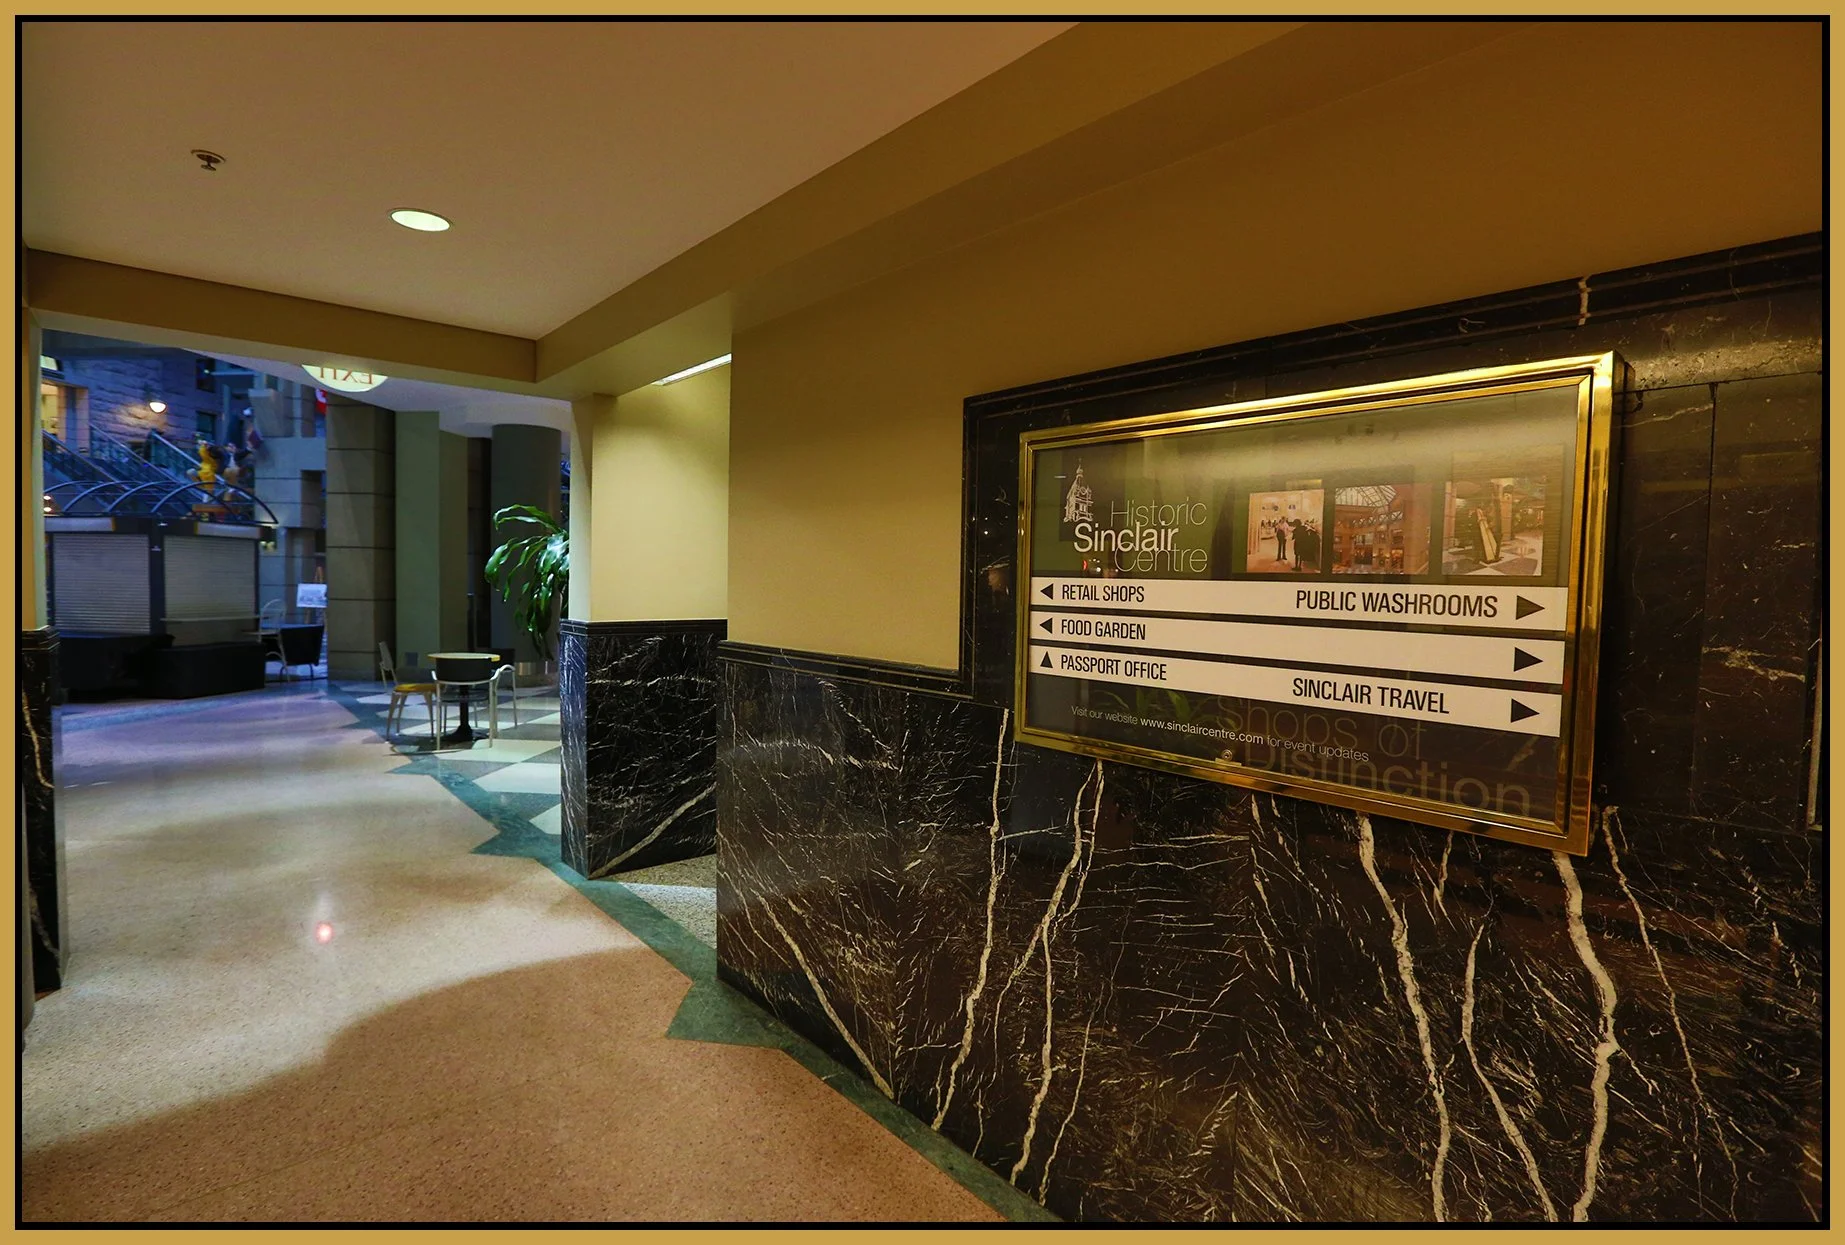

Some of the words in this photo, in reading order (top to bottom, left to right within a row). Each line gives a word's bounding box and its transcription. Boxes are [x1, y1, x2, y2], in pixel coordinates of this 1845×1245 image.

[1110, 496, 1208, 527] Historic
[1073, 521, 1179, 553] Sinclair
[1114, 541, 1208, 573] Centre
[1061, 584, 1100, 601] RETAIL
[1102, 585, 1145, 603] SHOPS
[1296, 590, 1356, 612] PUBLIC
[1362, 592, 1498, 618] WASHROOMS
[1061, 619, 1092, 636] FOOD
[1095, 621, 1146, 641] GARDEN
[1060, 654, 1121, 676] PASSPORT
[1124, 660, 1167, 681] OFFICE
[1292, 677, 1371, 705] SINCLAIR
[1377, 686, 1450, 714] TRAVEL
[1071, 706, 1088, 718] Visit
[1089, 709, 1103, 719] our
[1105, 711, 1138, 725] website
[1140, 717, 1264, 745] www.sinclaircentre.com
[1267, 735, 1282, 748] for
[1284, 740, 1316, 753] event
[1318, 745, 1370, 762] updates
